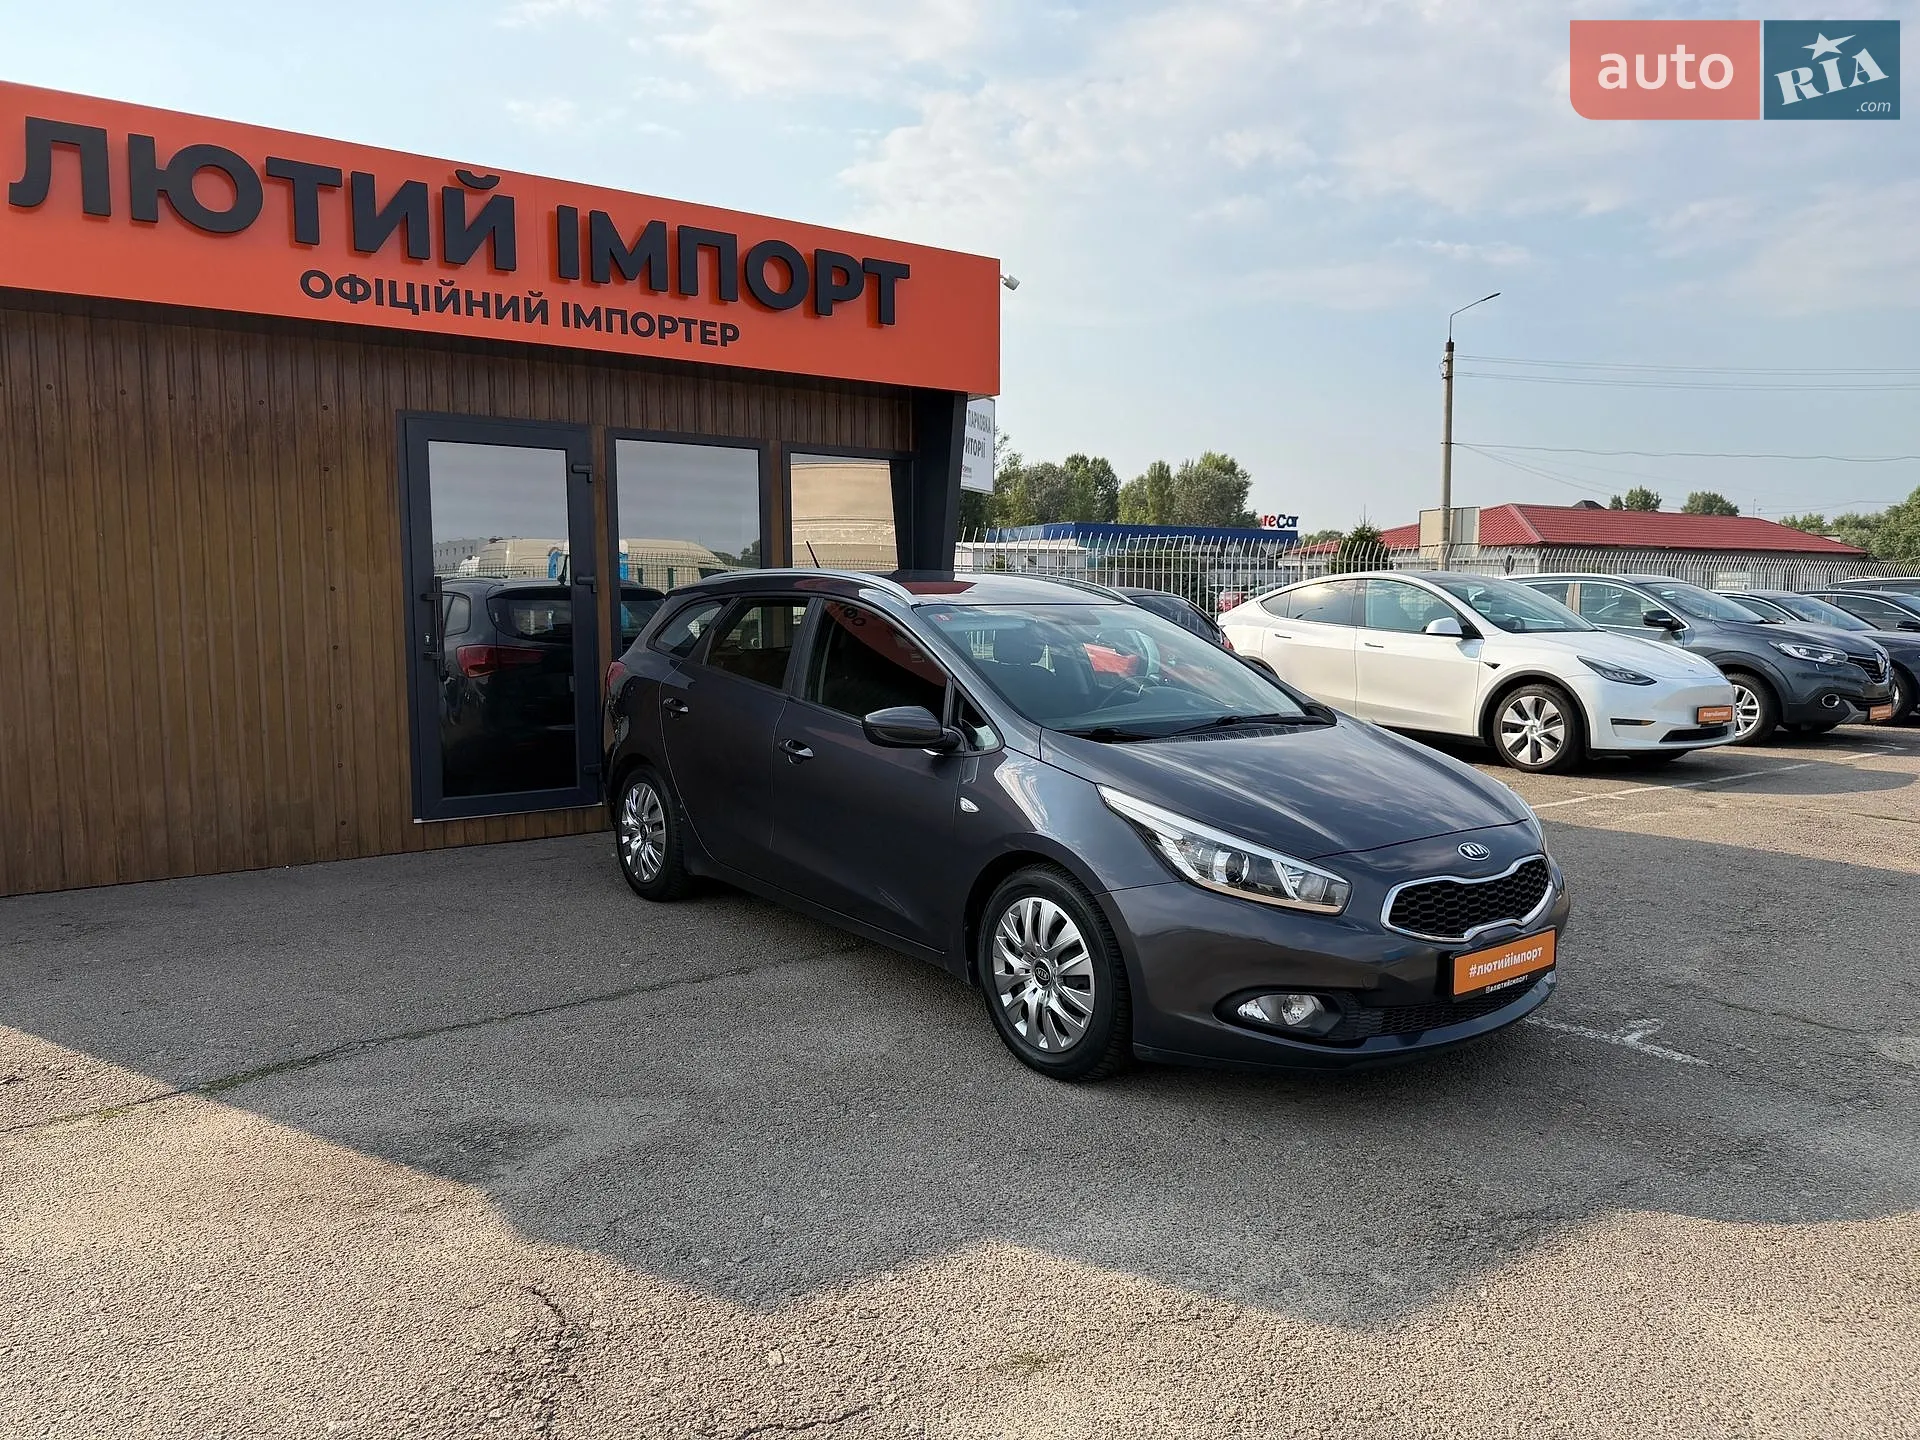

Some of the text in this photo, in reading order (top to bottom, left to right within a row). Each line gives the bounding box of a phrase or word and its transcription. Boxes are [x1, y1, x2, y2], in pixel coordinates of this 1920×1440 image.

[8, 115, 910, 326] ЛЮТИЙ ІМПОРТ
[300, 269, 740, 347] ОФІЦІЙНИЙ ІМПОРТЕР
[1468, 946, 1544, 979] #лютийімпорт
